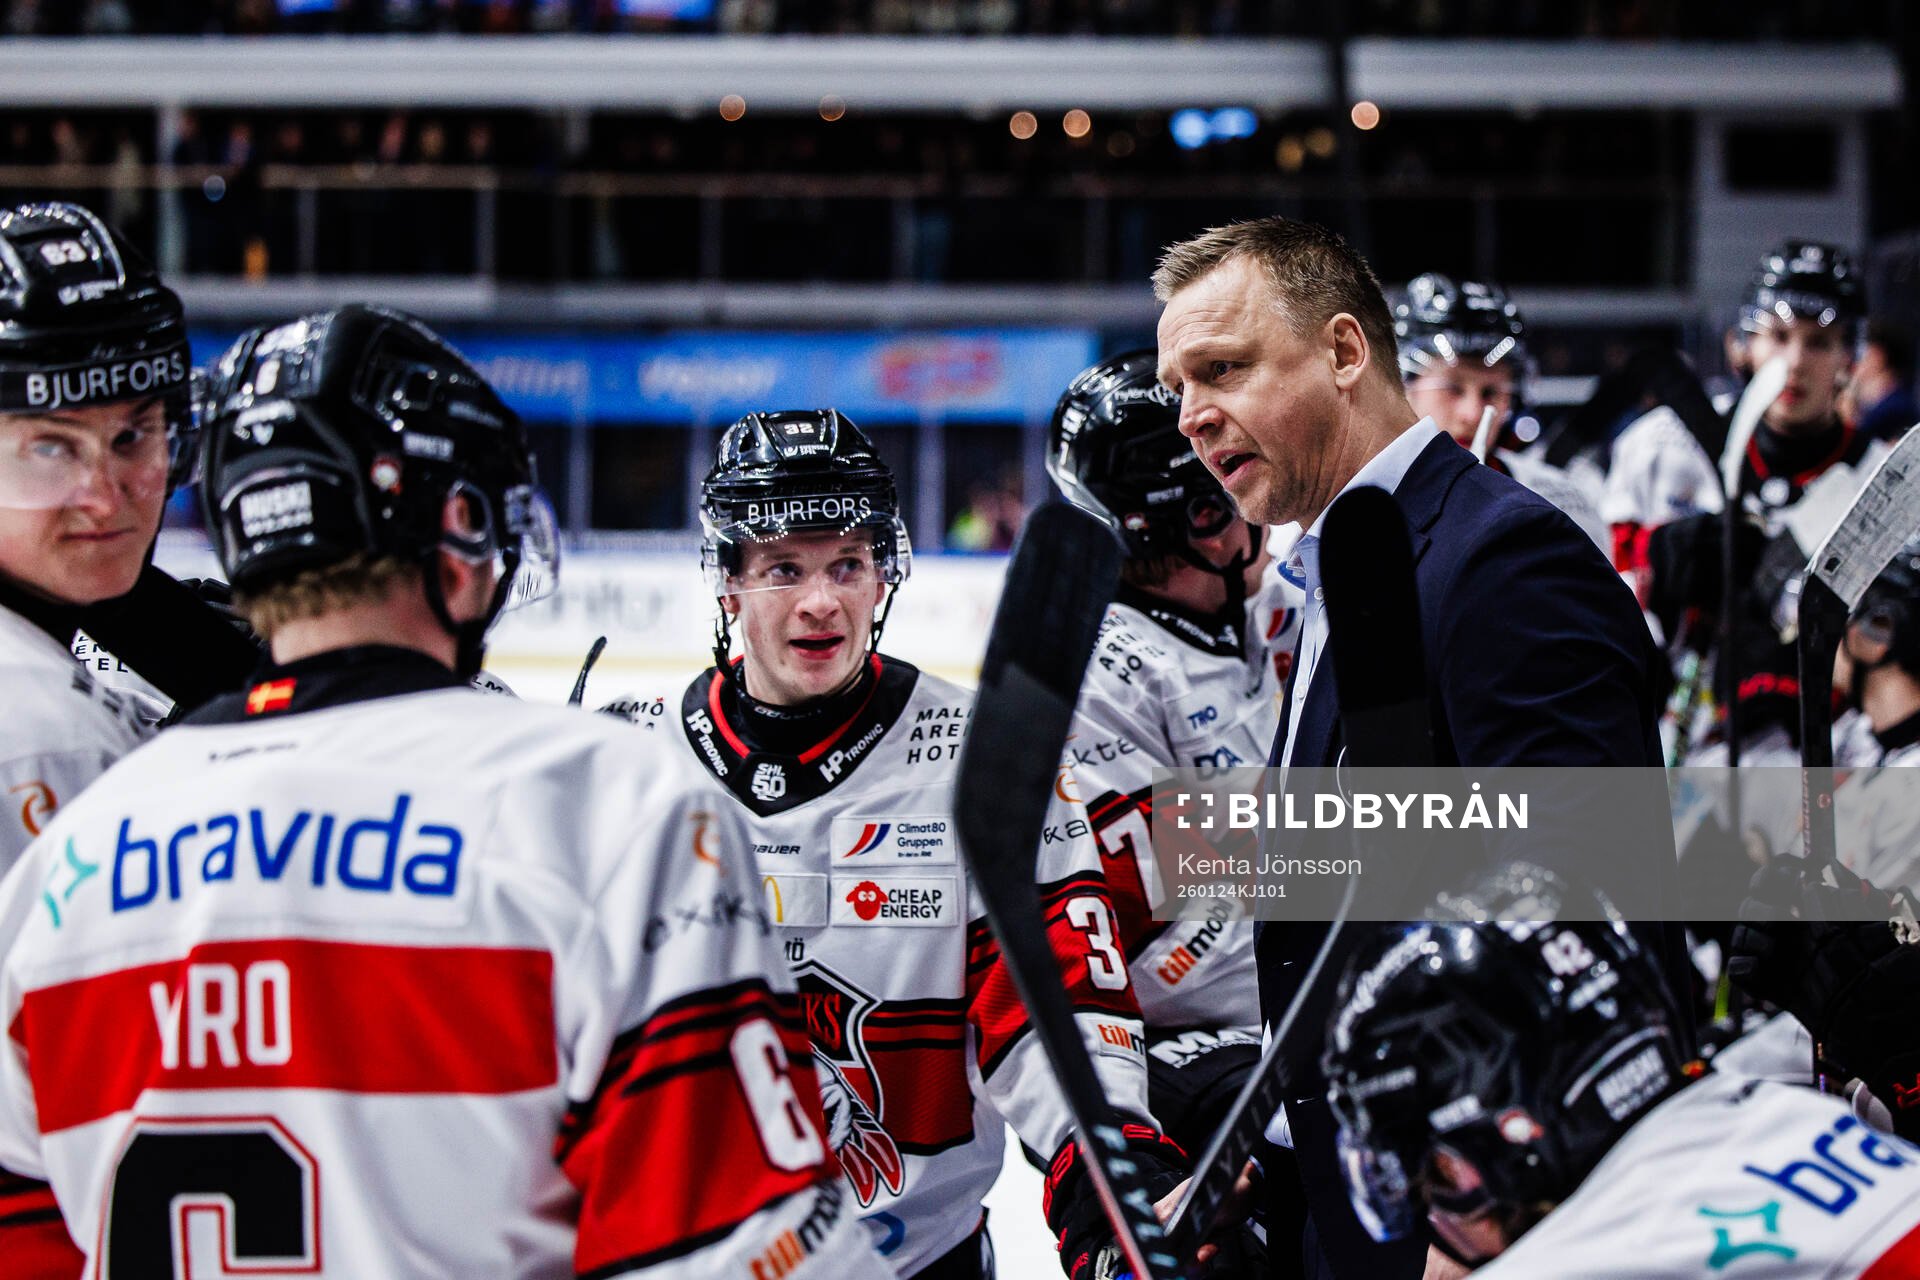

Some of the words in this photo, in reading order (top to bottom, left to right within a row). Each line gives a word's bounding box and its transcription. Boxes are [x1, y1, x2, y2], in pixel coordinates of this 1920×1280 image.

[26, 351, 186, 409] BJURFORS
[784, 423, 815, 435] 32
[747, 497, 871, 527] BJURFORS
[916, 707, 973, 723] MAL
[910, 724, 969, 742] ARE
[897, 822, 946, 834] Climat80
[897, 837, 943, 848] Gruppen
[112, 795, 464, 913] bravida
[1099, 808, 1167, 911] 7
[888, 889, 942, 904] CHEAP
[881, 905, 942, 918] ENERGY
[1065, 896, 1129, 992] 3
[730, 1017, 825, 1172] 6
